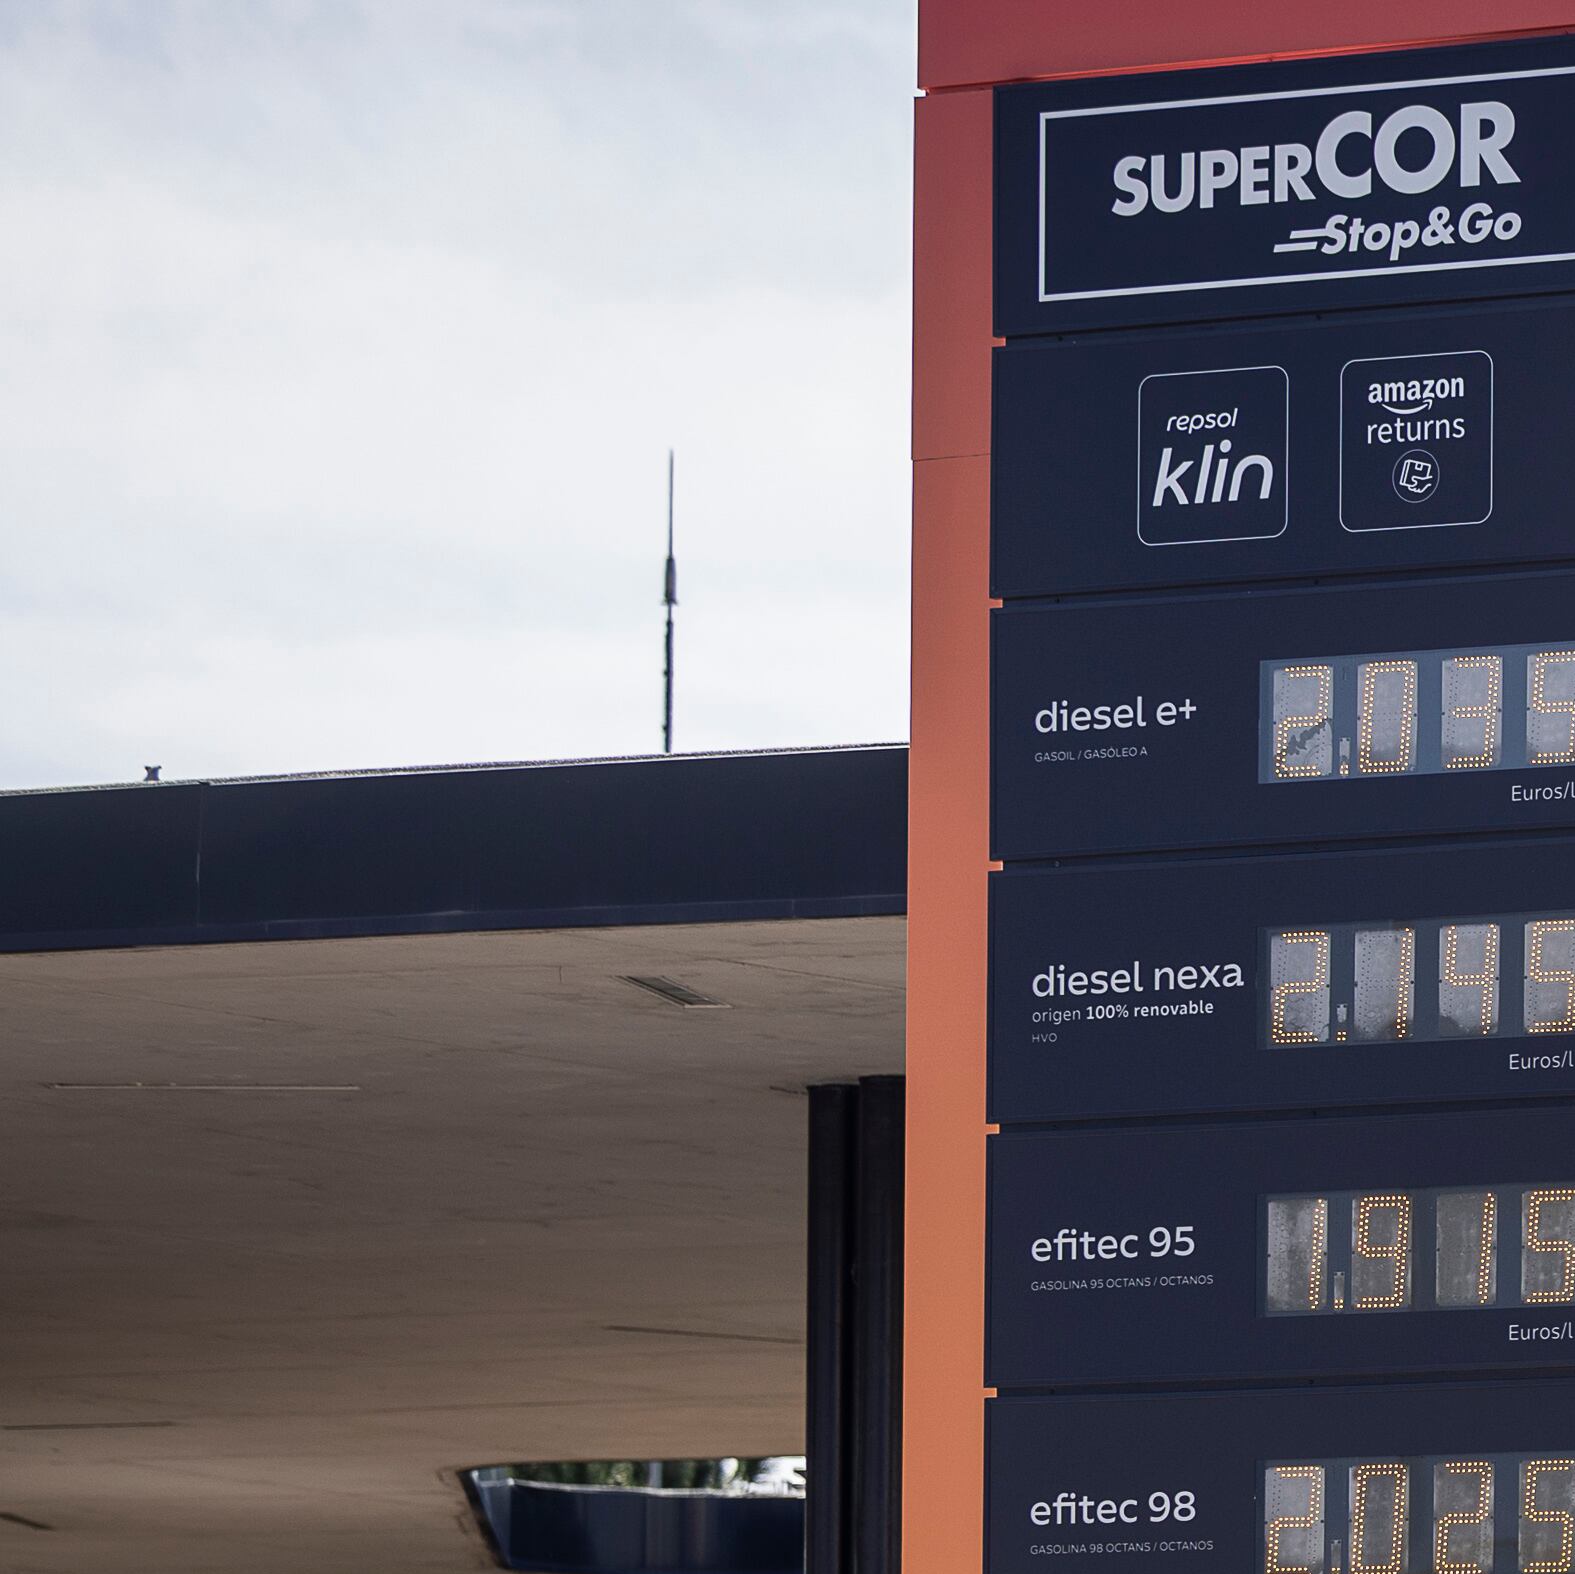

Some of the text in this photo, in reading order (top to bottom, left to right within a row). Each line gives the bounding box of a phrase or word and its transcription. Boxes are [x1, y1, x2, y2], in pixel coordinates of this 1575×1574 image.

[1112, 101, 1521, 215] SUPERCOR
[1320, 203, 1522, 260] Stop&Go
[1367, 376, 1466, 406] amazon
[1166, 407, 1238, 434] repsol
[1367, 413, 1466, 445] returns
[1152, 440, 1274, 507] klin
[1035, 696, 1197, 733] diesel e+
[1034, 751, 1076, 763] GASOIL
[1083, 746, 1138, 760] GASÓLEO
[1139, 746, 1149, 756] A
[1511, 781, 1575, 802] Euros/l
[1032, 960, 1245, 998] diesel nexa
[1032, 999, 1214, 1025] origen 100% renovable
[1031, 1032, 1058, 1043] HVO
[1509, 1050, 1574, 1070] Euros/l
[1031, 1225, 1195, 1262] efitec 95
[1031, 1279, 1088, 1291] GASOLINA
[1090, 1278, 1104, 1289] 95
[1106, 1277, 1151, 1288] OCTANS
[1159, 1274, 1214, 1286] OCTANOS
[1508, 1321, 1574, 1341] Euros/l
[1030, 1490, 1196, 1526] efitec 98
[1030, 1544, 1087, 1555] GASOLINA
[1089, 1543, 1104, 1553] 98
[1105, 1542, 1151, 1553] OCTANS
[1159, 1540, 1214, 1551] OCTANOS
